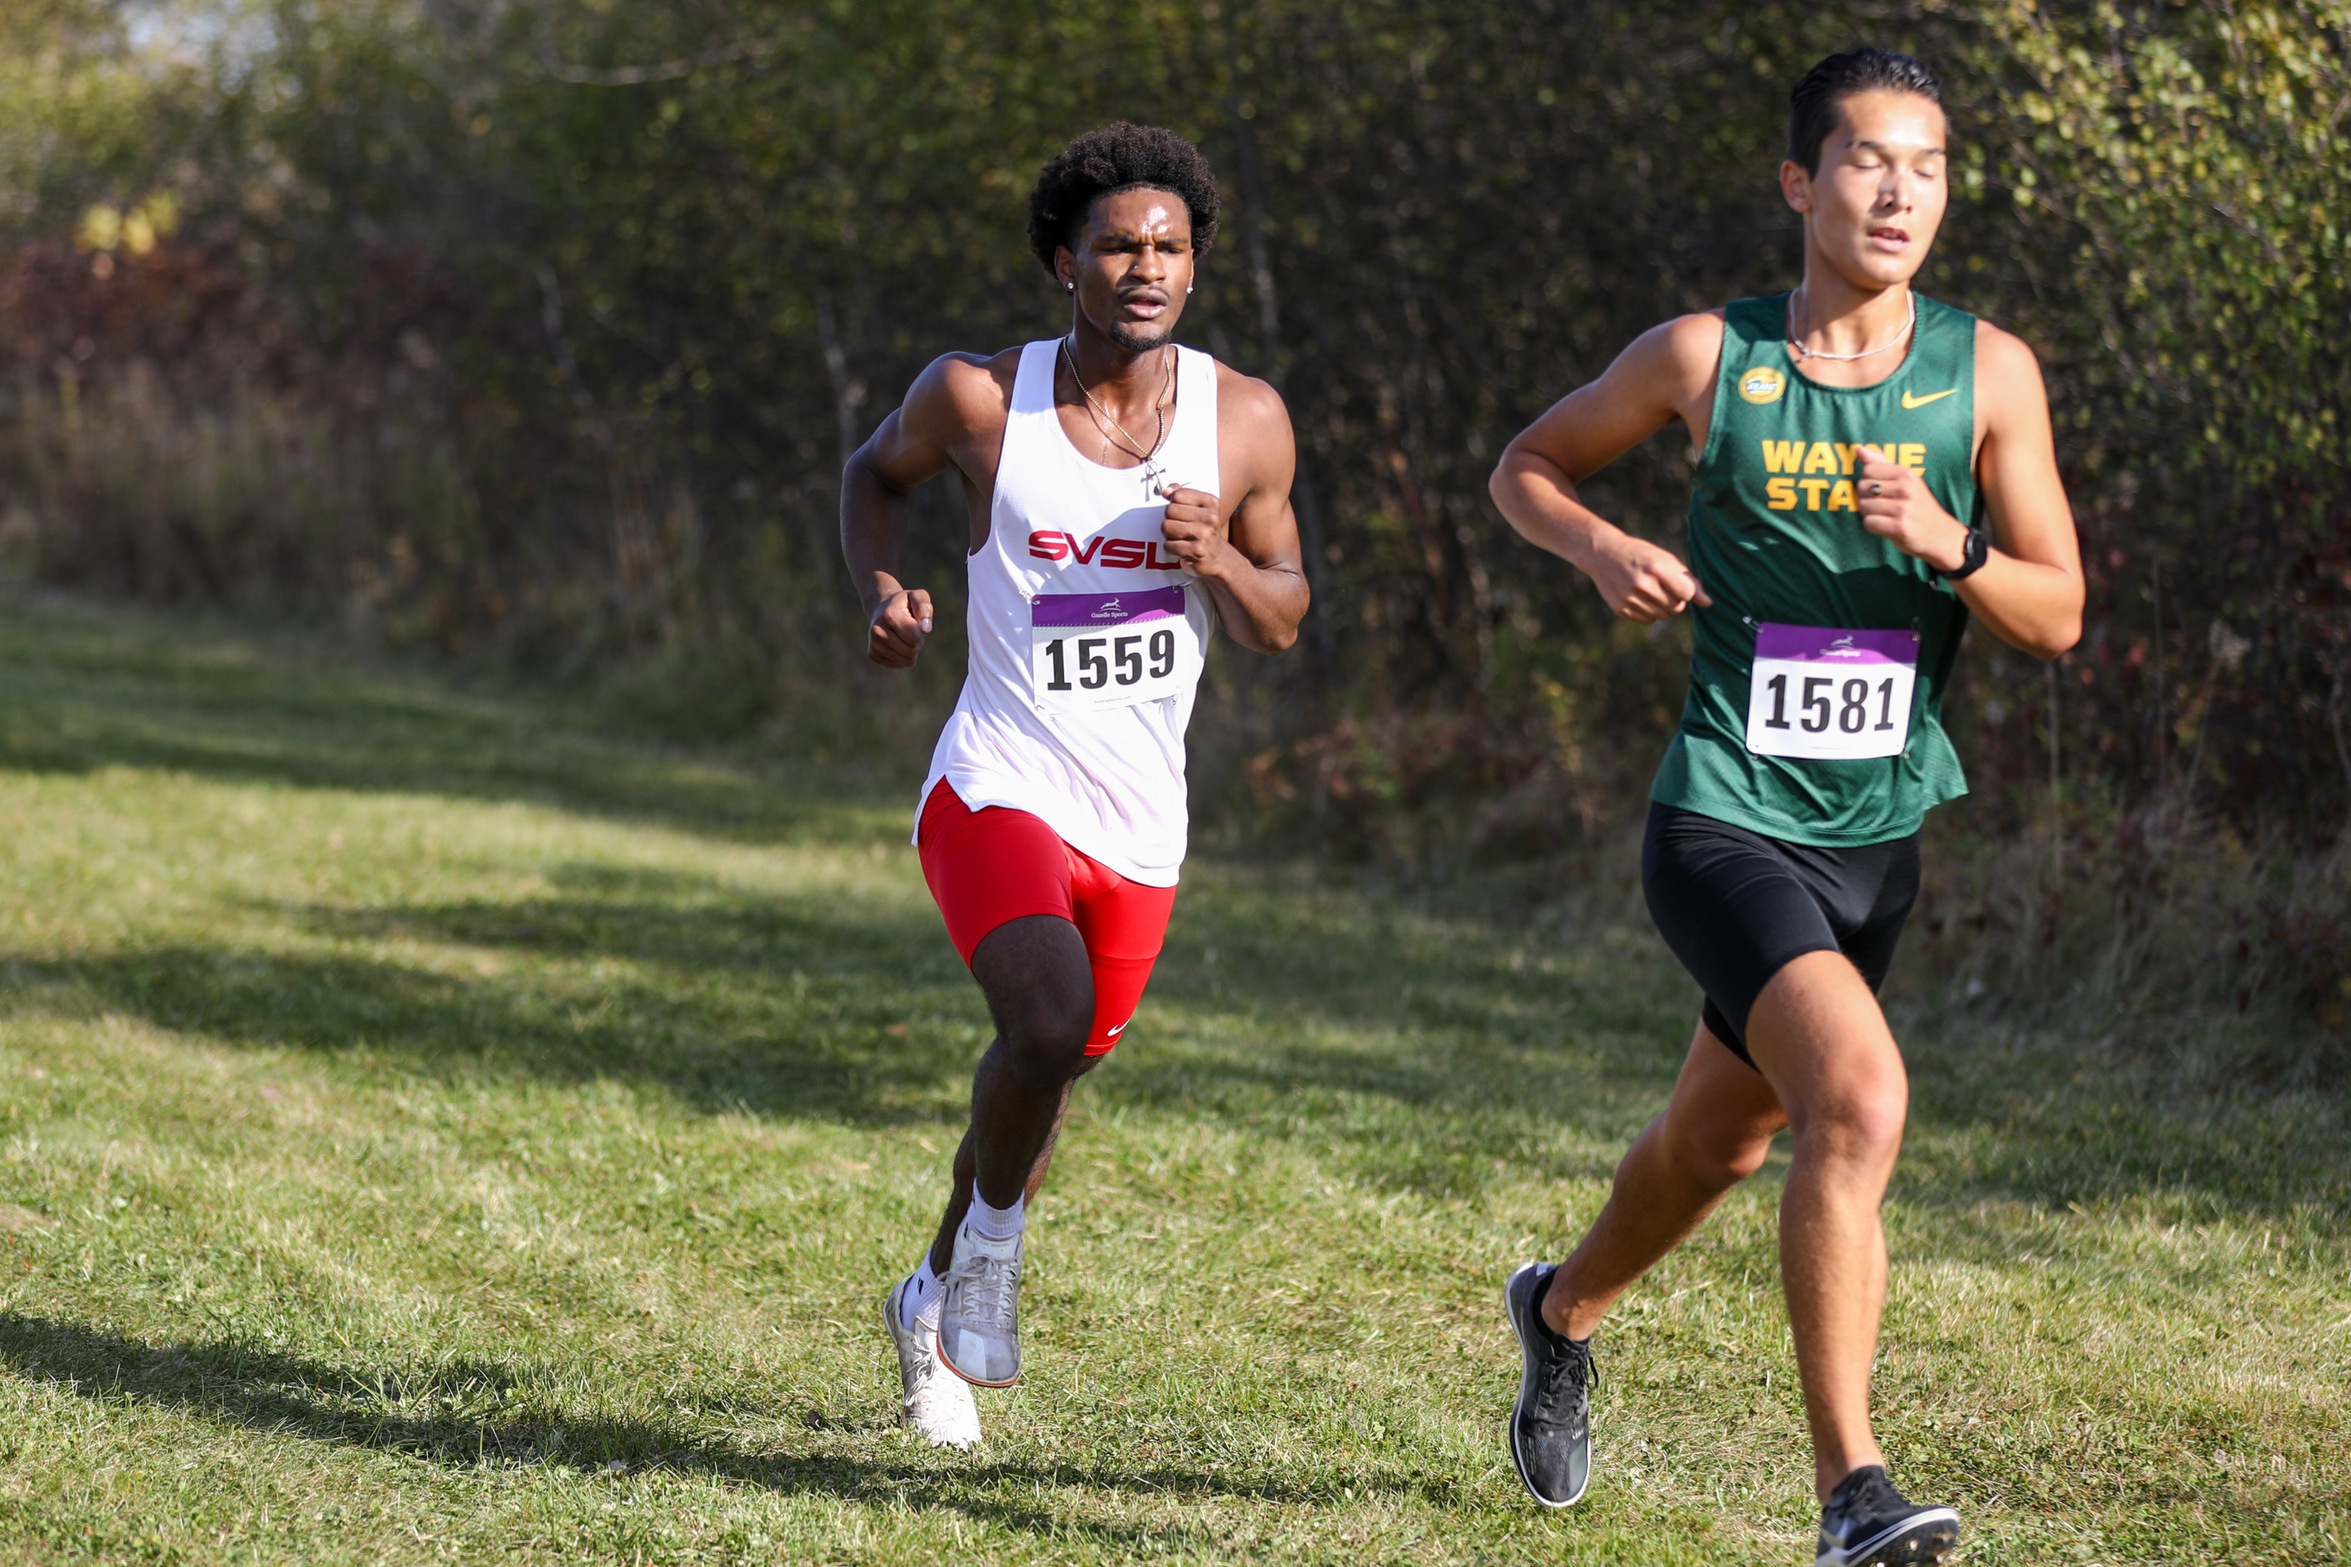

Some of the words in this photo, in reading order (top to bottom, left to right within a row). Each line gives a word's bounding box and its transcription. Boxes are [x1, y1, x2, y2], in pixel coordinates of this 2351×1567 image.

[1764, 477, 1860, 512] STA
[1111, 611, 1128, 619] Sports
[1045, 629, 1175, 691] 1559
[1765, 674, 1894, 734] 1581
